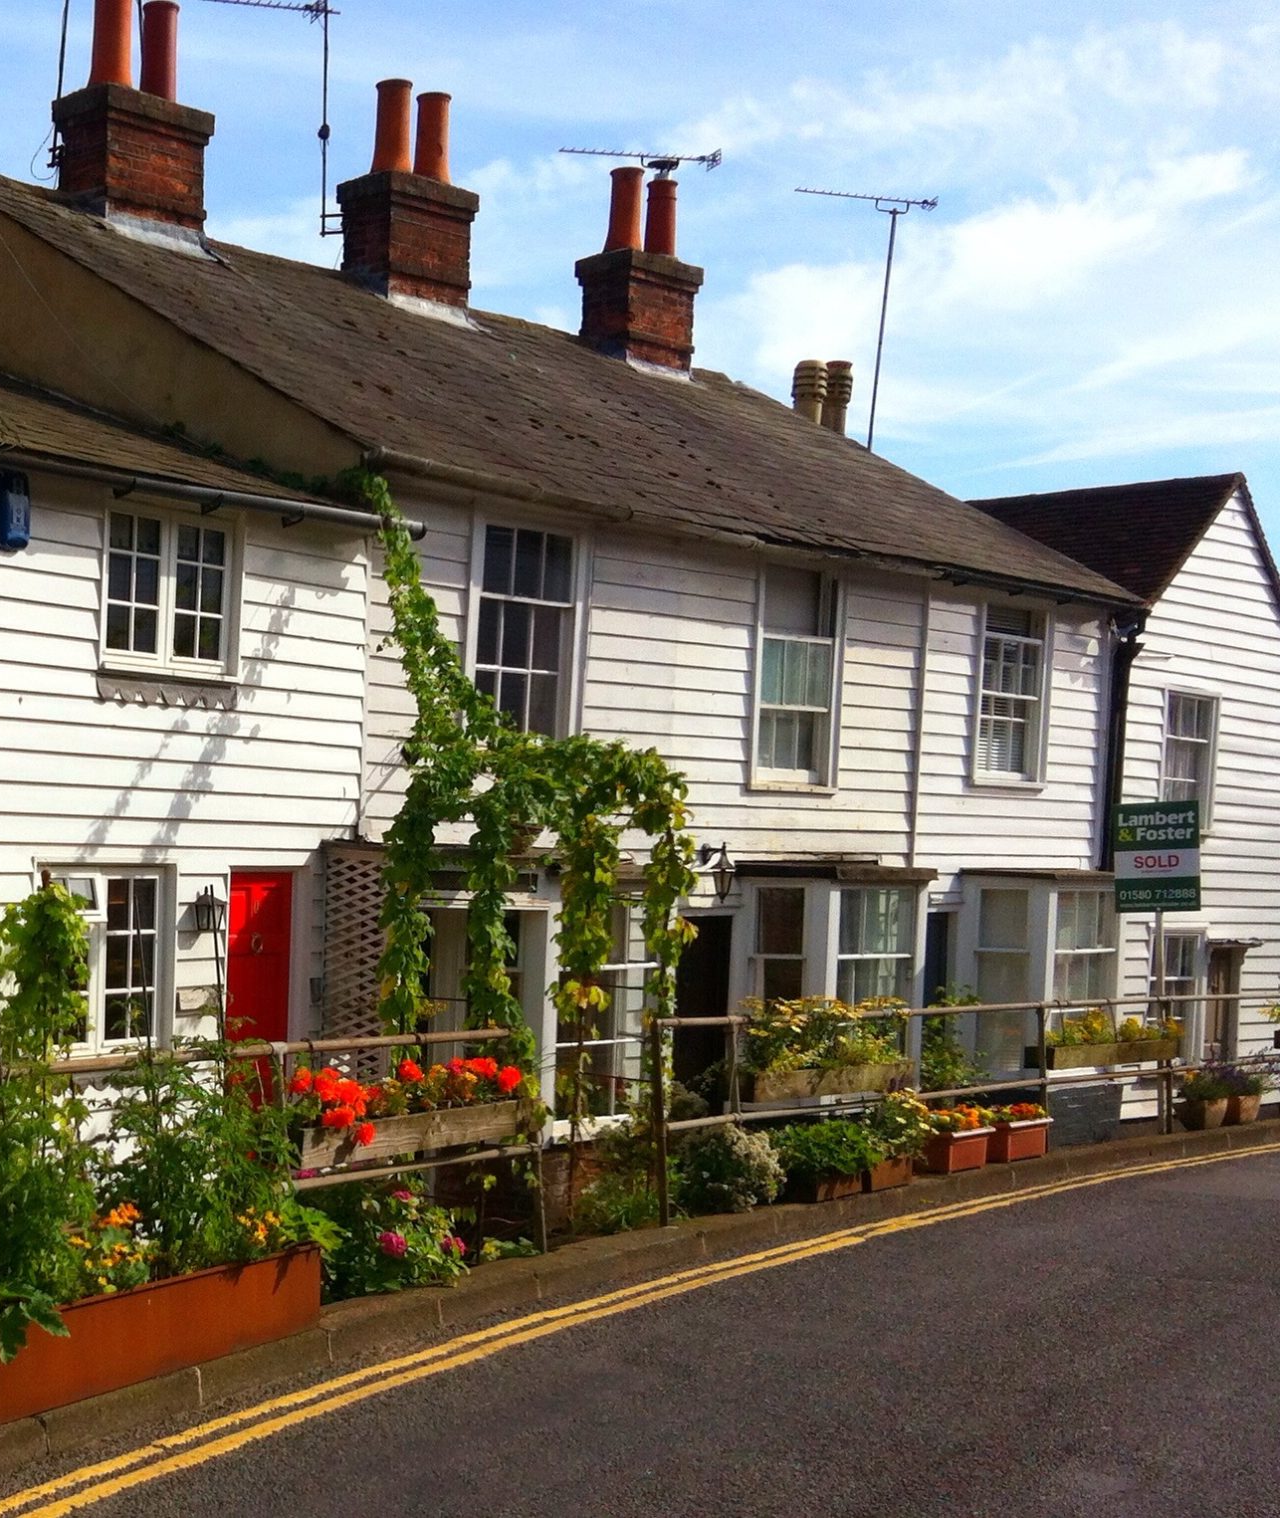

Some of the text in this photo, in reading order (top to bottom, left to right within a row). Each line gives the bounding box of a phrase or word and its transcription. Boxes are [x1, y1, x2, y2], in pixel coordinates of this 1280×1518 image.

[1118, 811, 1195, 827] Lambert
[1118, 827, 1194, 841] & Foster
[1134, 855, 1179, 869] SOLD
